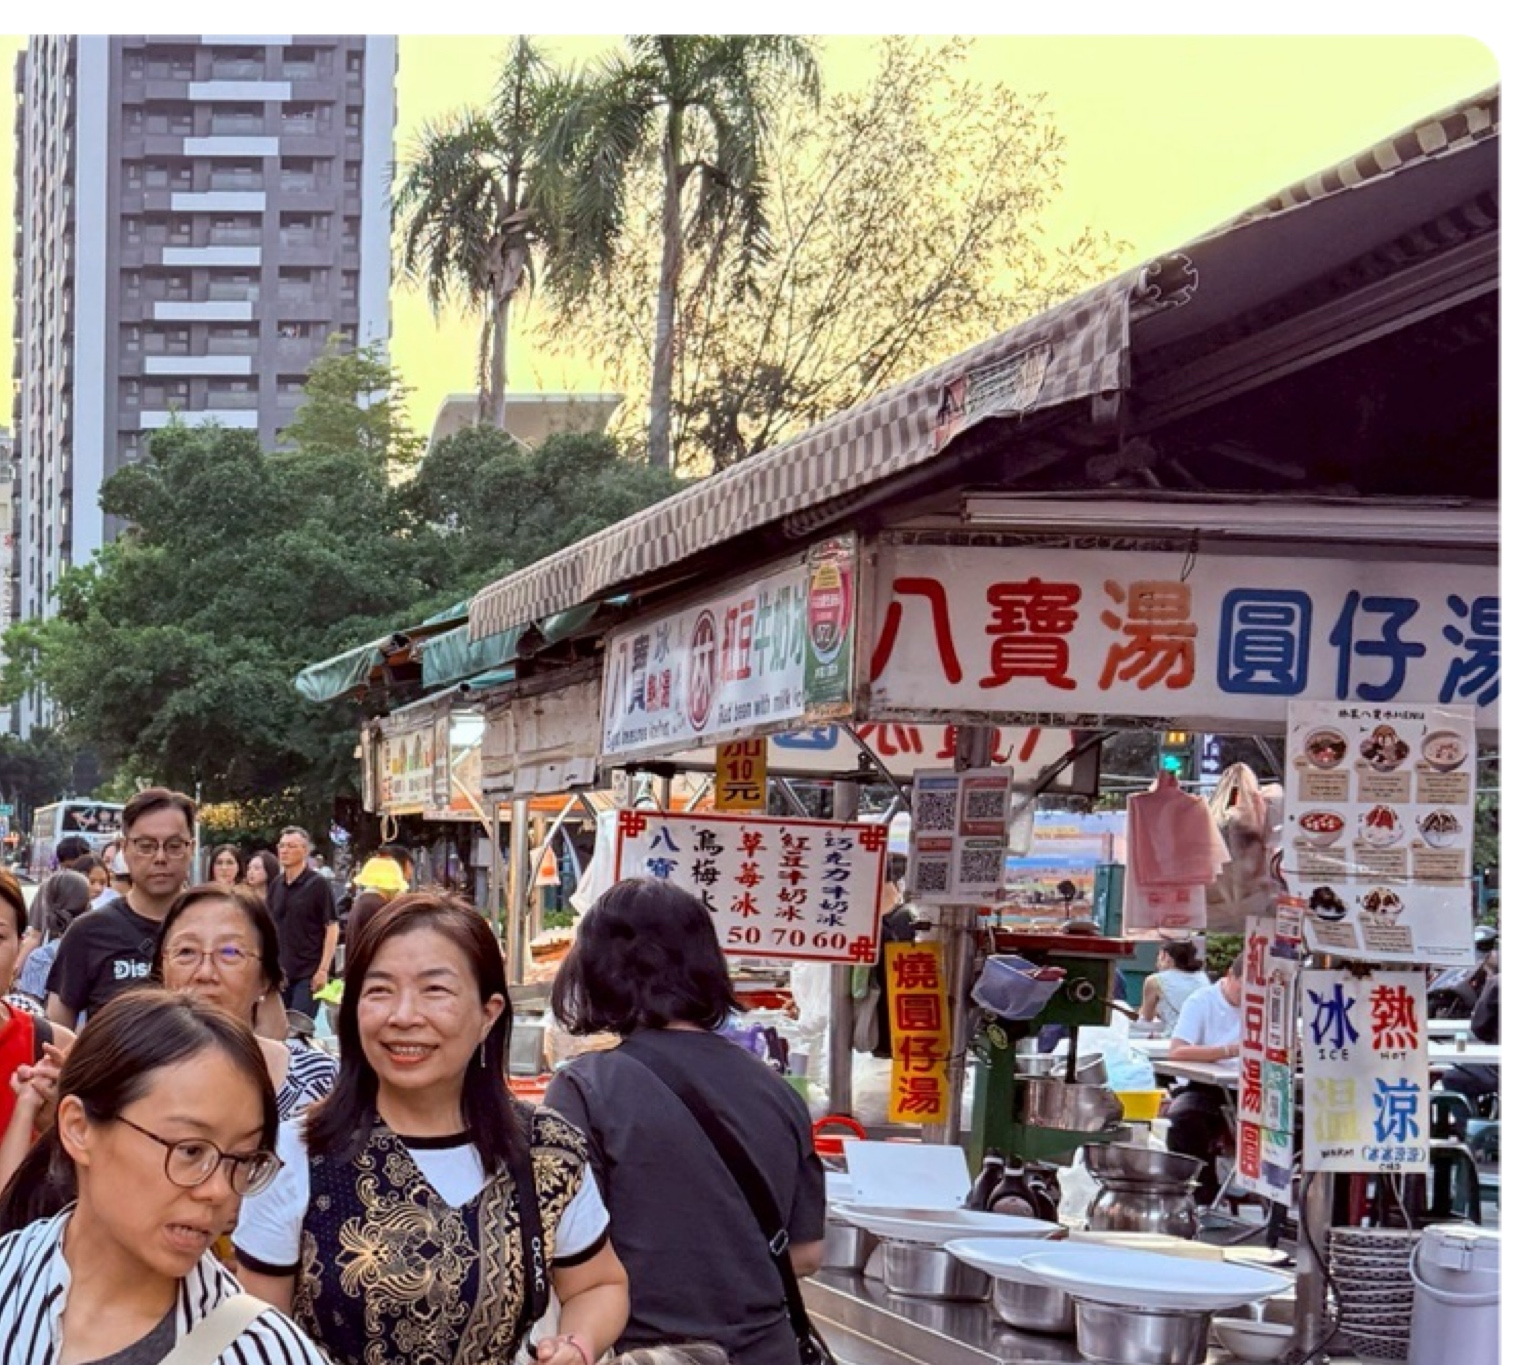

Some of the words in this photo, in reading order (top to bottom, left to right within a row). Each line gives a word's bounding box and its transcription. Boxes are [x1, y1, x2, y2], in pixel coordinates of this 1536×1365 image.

[730, 831, 767, 918] 草莓冰
[774, 834, 811, 921] 紅豆牛奶冰
[726, 927, 761, 944] 50
[772, 929, 806, 947] 70
[814, 932, 847, 950] 60
[113, 958, 153, 980] Dis
[893, 952, 942, 1114] 燒圓仔湯
[1308, 983, 1360, 1049] 冰
[1369, 985, 1419, 1050] 熱
[1318, 1048, 1349, 1061] ICE
[1372, 1077, 1421, 1143] 涼
[531, 1236, 545, 1293] OCAC
